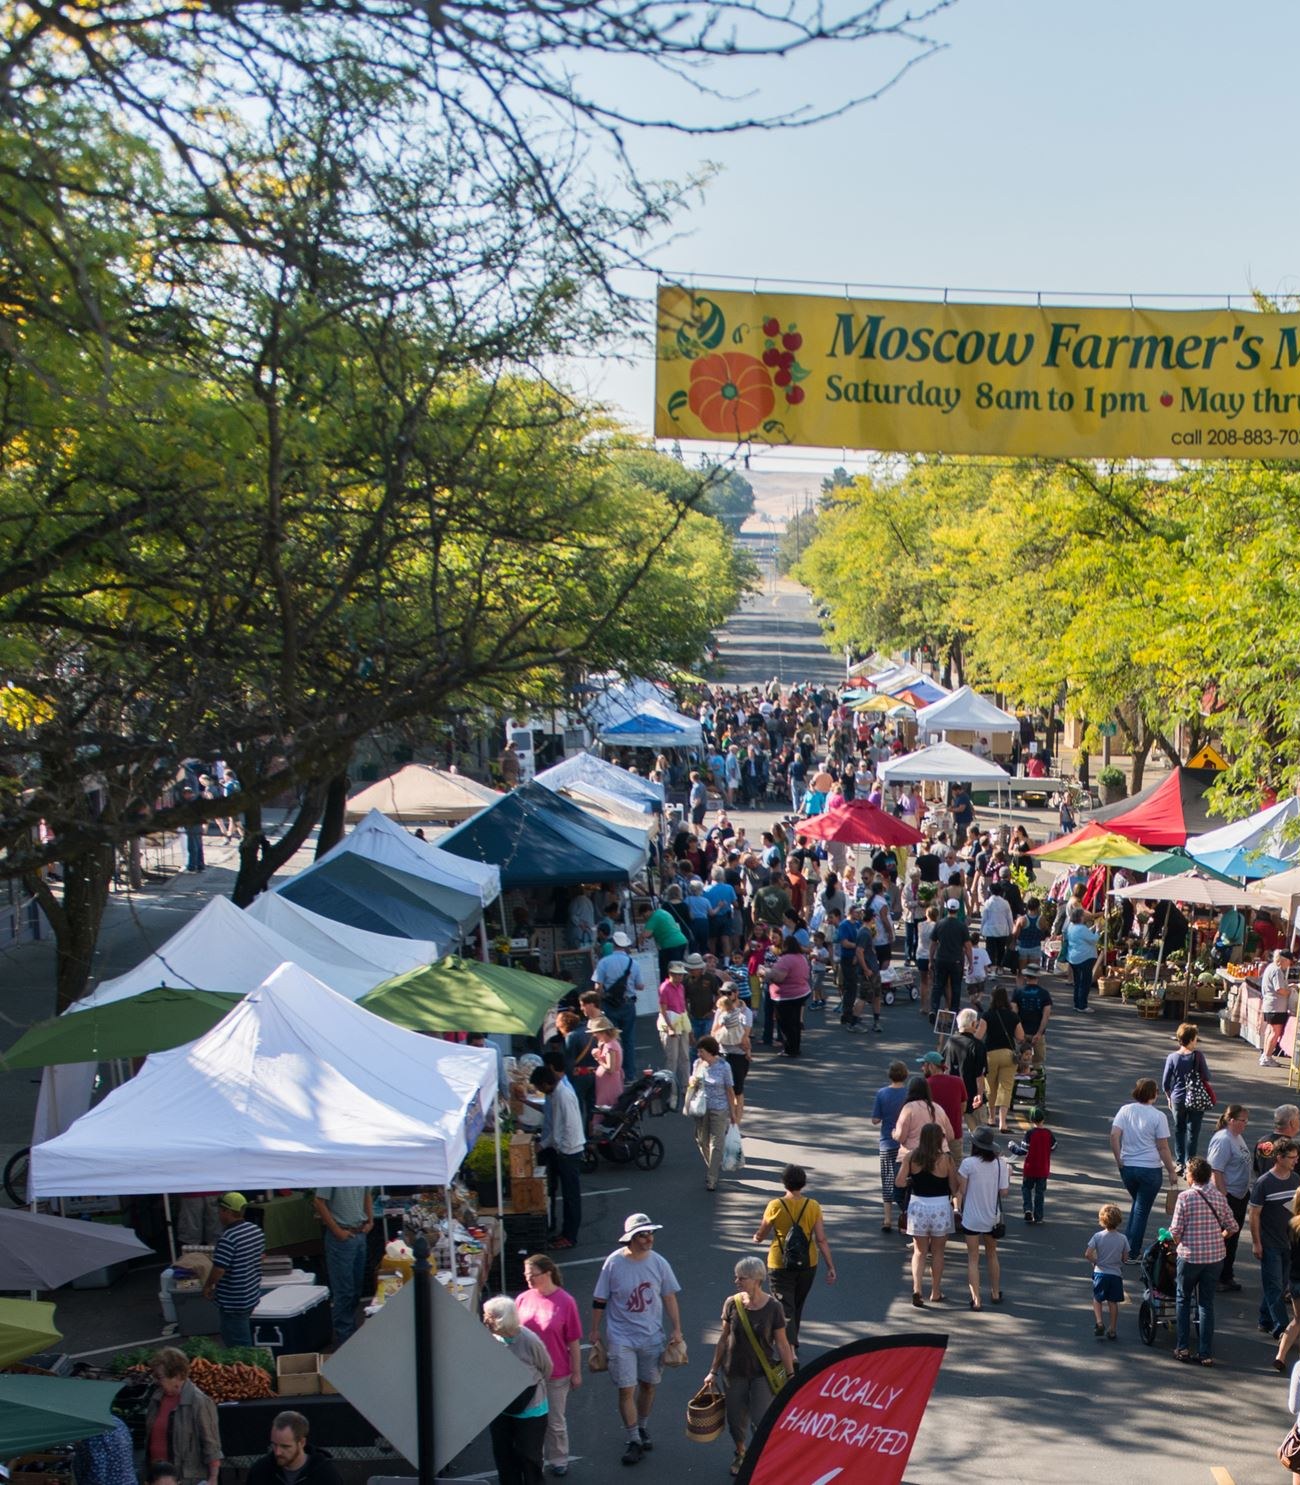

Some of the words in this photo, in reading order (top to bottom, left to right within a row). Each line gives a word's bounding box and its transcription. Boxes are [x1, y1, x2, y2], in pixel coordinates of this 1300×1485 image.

[826, 313, 1035, 366] Moscow
[1041, 322, 1264, 370] Farmer's
[826, 374, 961, 414] Saturday
[975, 382, 1042, 410] 8am
[1048, 387, 1074, 412] to
[1180, 386, 1245, 419] May
[1171, 429, 1202, 445] call
[820, 1373, 903, 1410] LOCALLY
[780, 1407, 909, 1456] HANDCRAFTED
